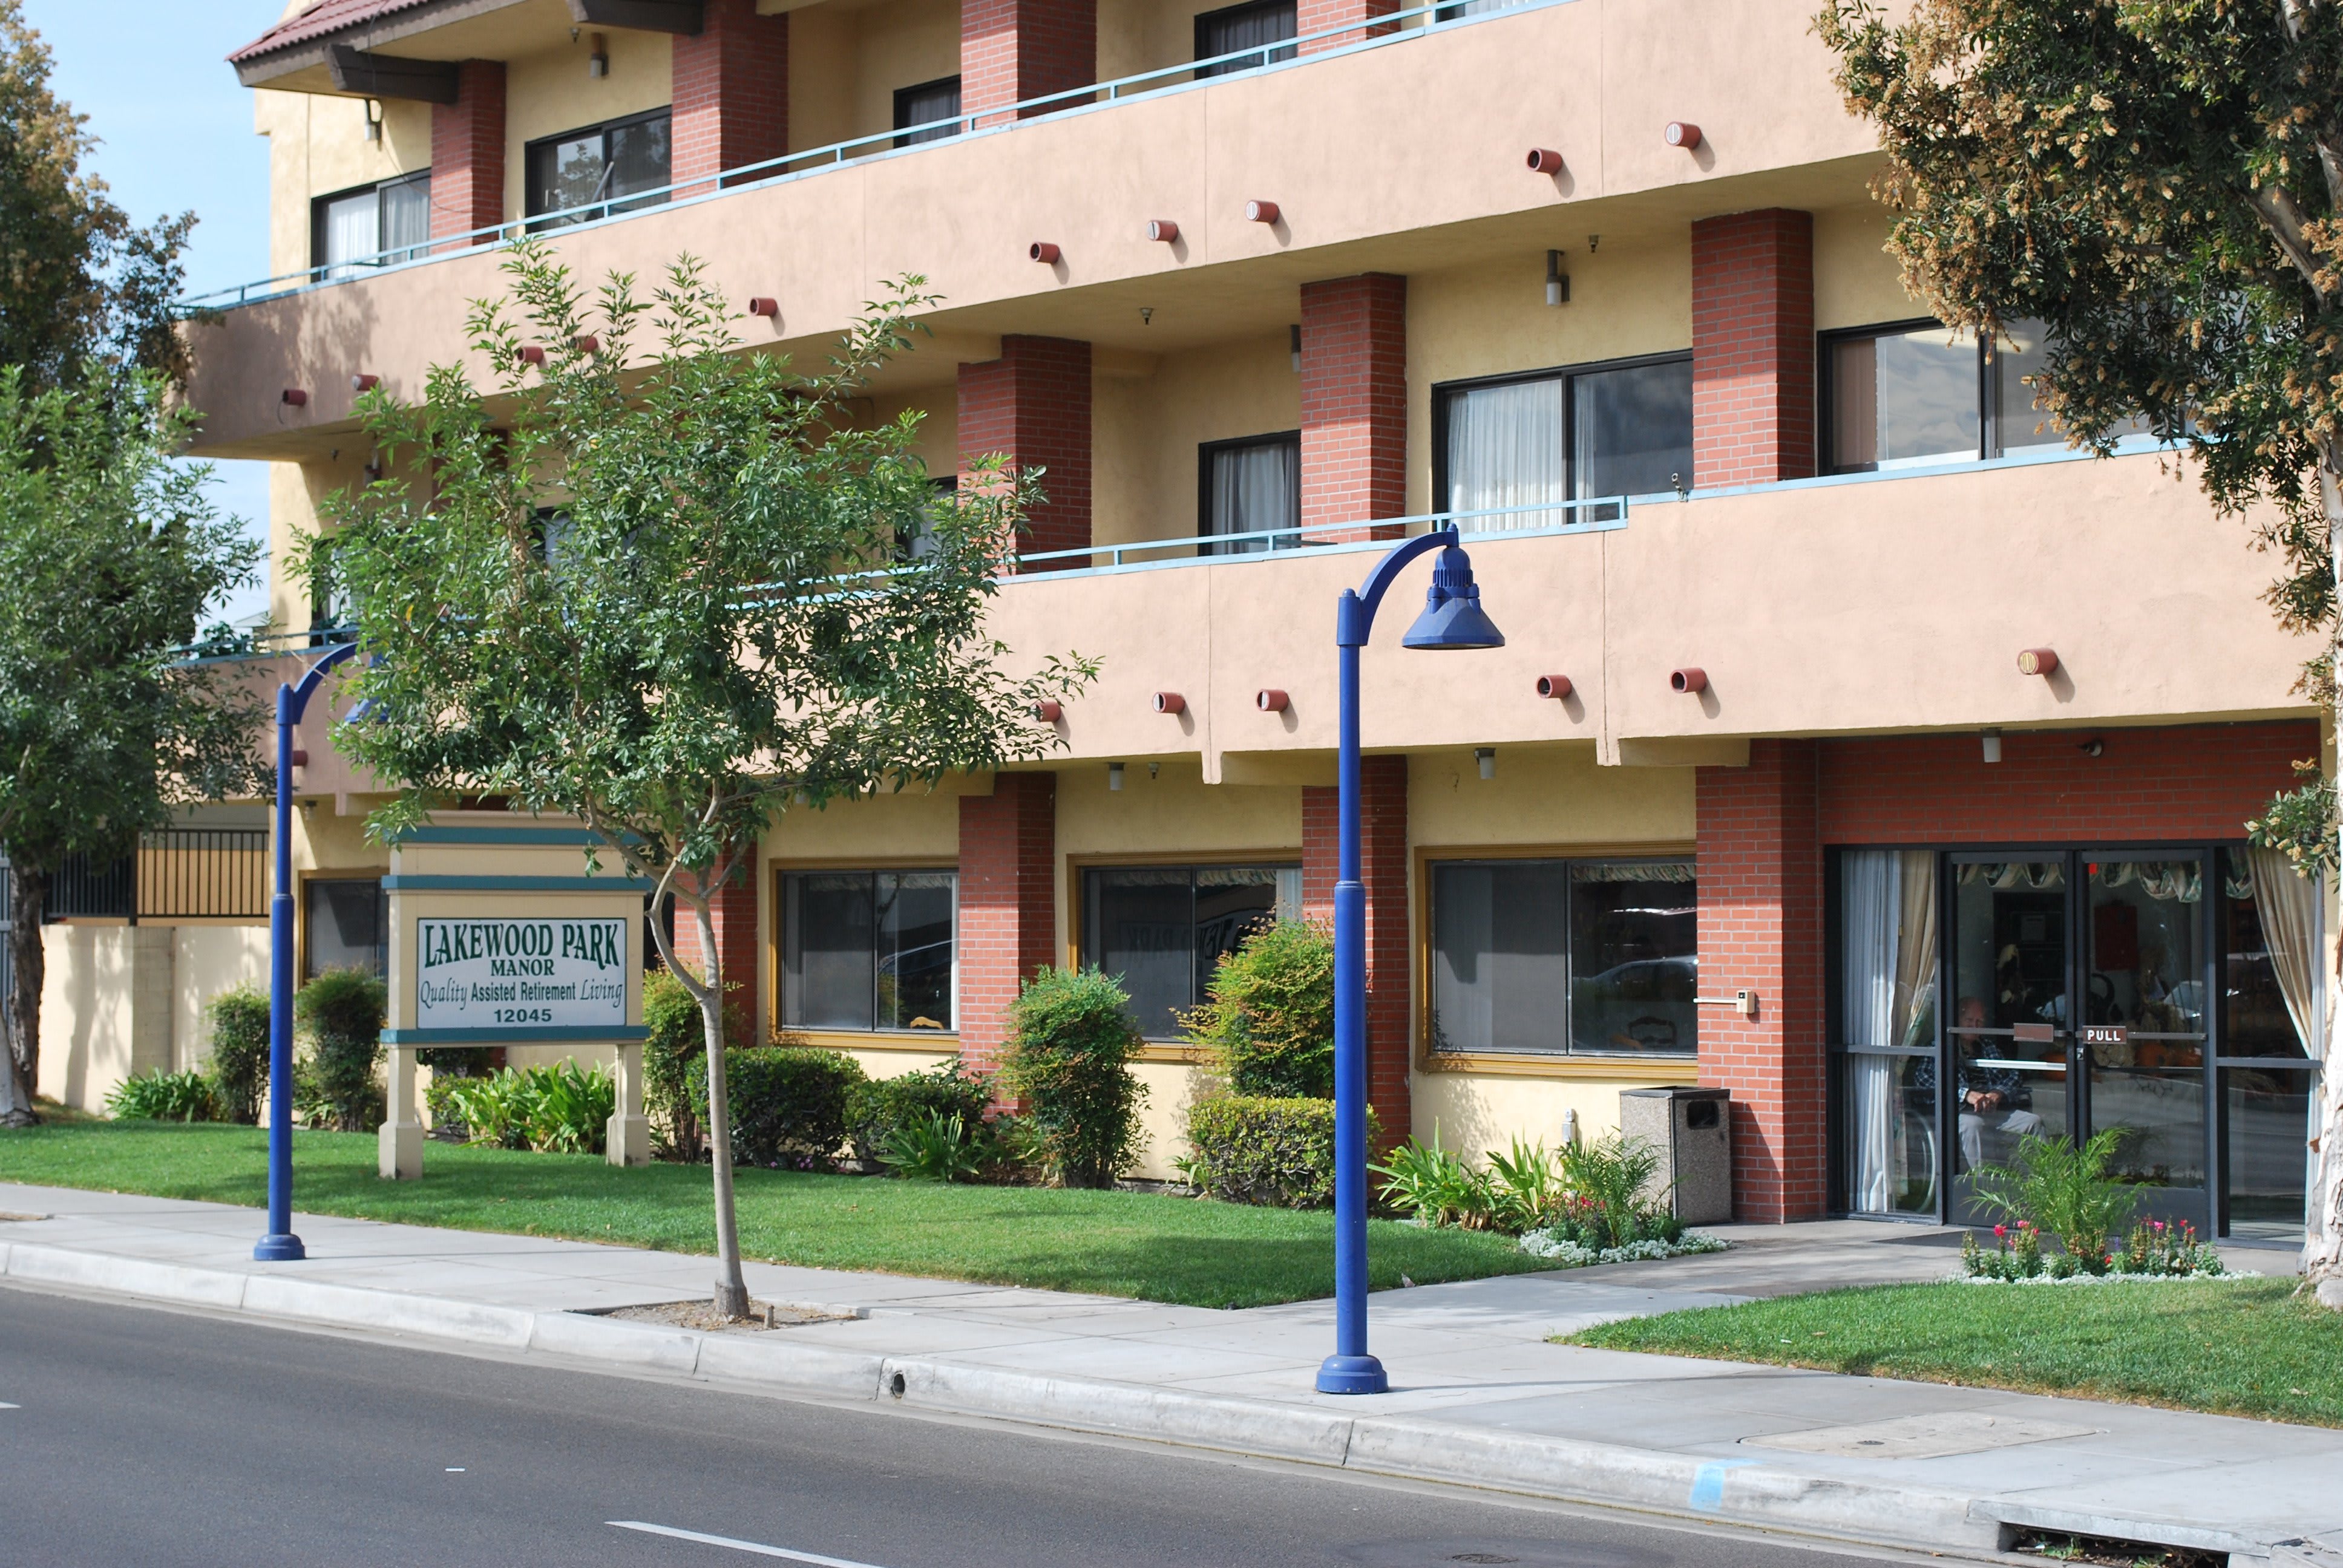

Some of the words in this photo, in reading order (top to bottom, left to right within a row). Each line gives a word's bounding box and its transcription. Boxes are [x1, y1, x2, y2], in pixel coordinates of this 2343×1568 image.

[425, 923, 553, 968] LAKEWOOD
[562, 923, 619, 970] PARK
[491, 959, 555, 976] MANOR
[421, 977, 467, 1010] Quality
[471, 981, 516, 1002] Assisted
[520, 981, 576, 1001] Retirement
[580, 978, 623, 1008] Living
[494, 1008, 552, 1022] 12045
[2087, 1030, 2121, 1041] PULL
